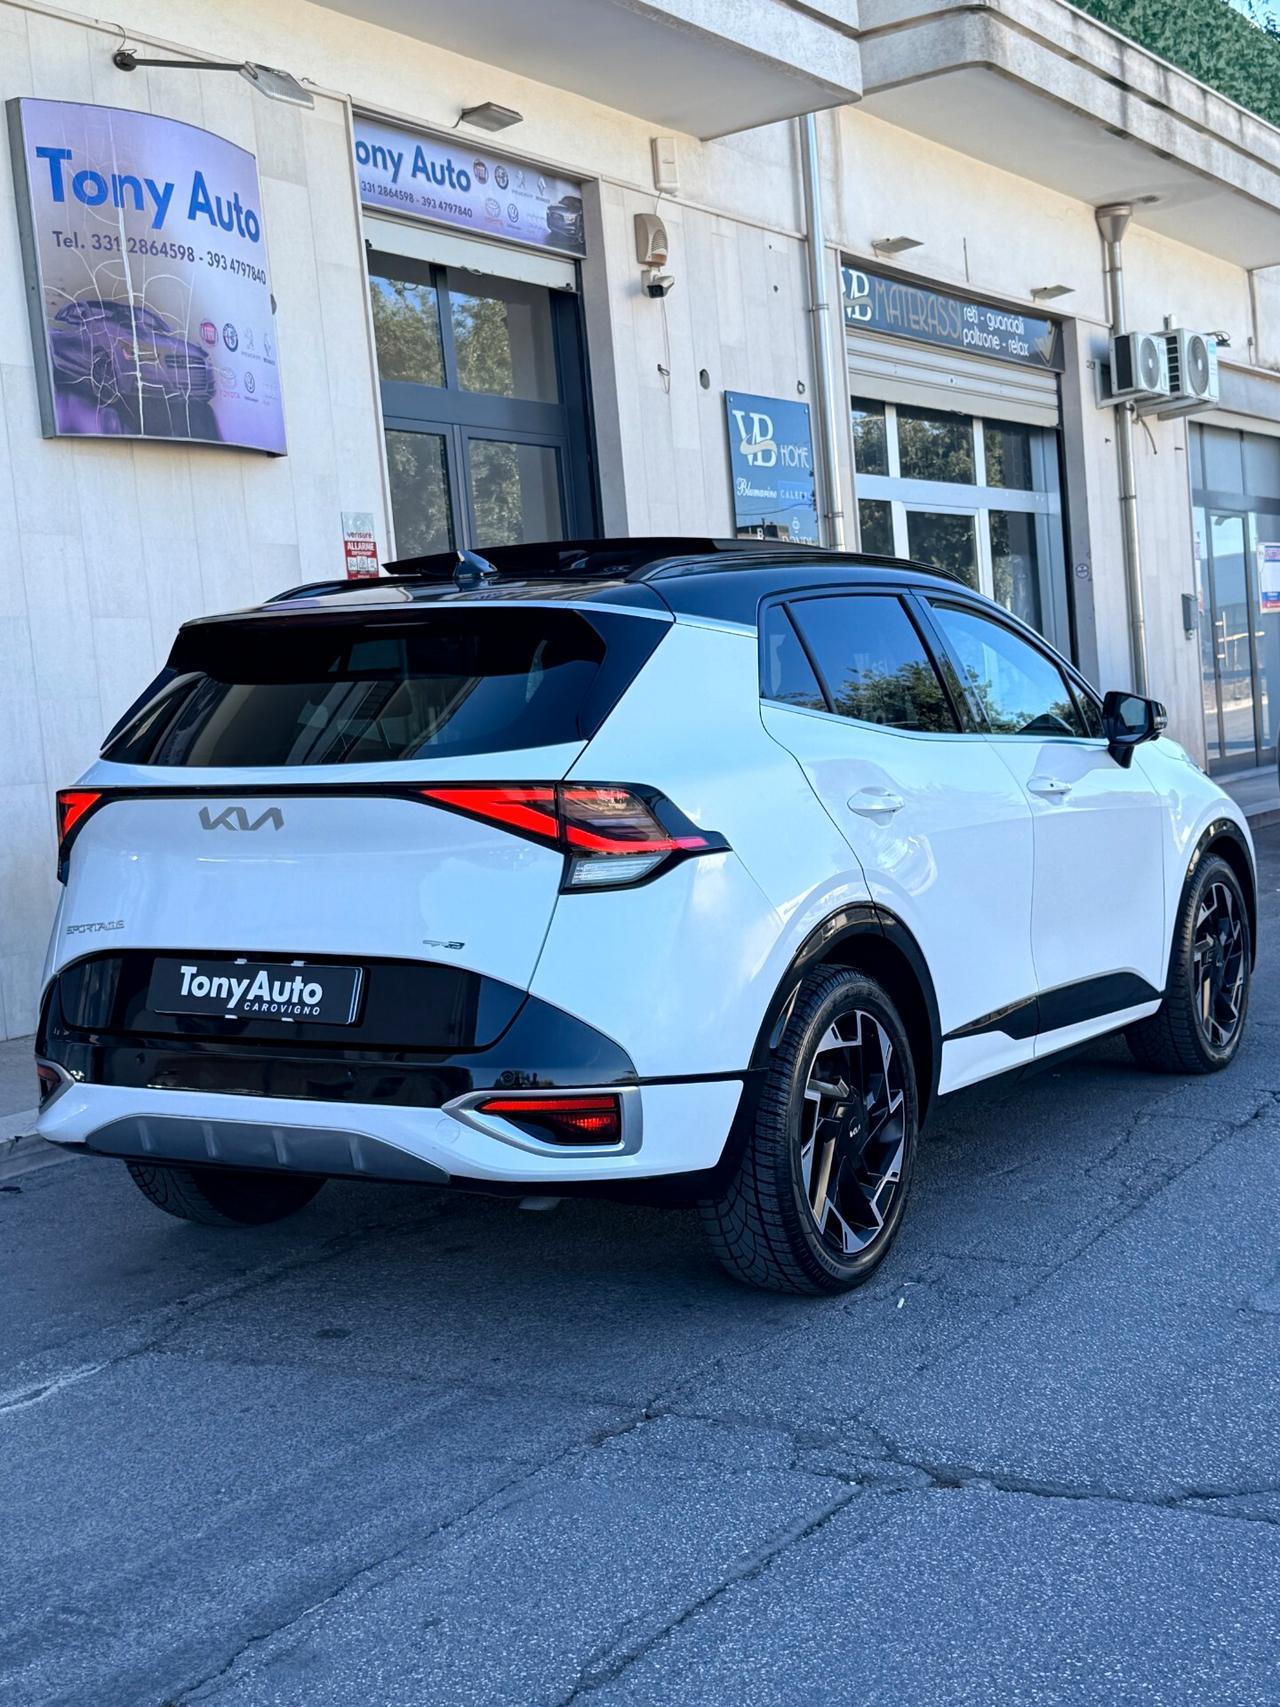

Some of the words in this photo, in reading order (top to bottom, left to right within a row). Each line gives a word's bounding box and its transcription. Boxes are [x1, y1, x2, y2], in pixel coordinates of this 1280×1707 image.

[355, 140, 403, 184] ony
[411, 144, 471, 192] Auto
[36, 146, 174, 230] Tony
[188, 170, 260, 243] Auto
[361, 181, 375, 193] 331
[378, 185, 414, 203] 2864598
[421, 196, 437, 209] 393
[438, 202, 473, 218] 4797840
[52, 231, 85, 249] Tel.
[92, 234, 121, 251] 331
[127, 237, 194, 262] 2864598
[207, 252, 227, 270] 393
[229, 258, 266, 285] 4797840
[875, 280, 962, 341] MATERASSI
[963, 326, 1000, 350] poltrone
[1008, 335, 1029, 357] relax
[780, 444, 810, 468] HOME
[347, 541, 375, 551] ALLARME
[198, 806, 284, 831] KIA
[244, 1002, 320, 1016] CAROVIGNO
